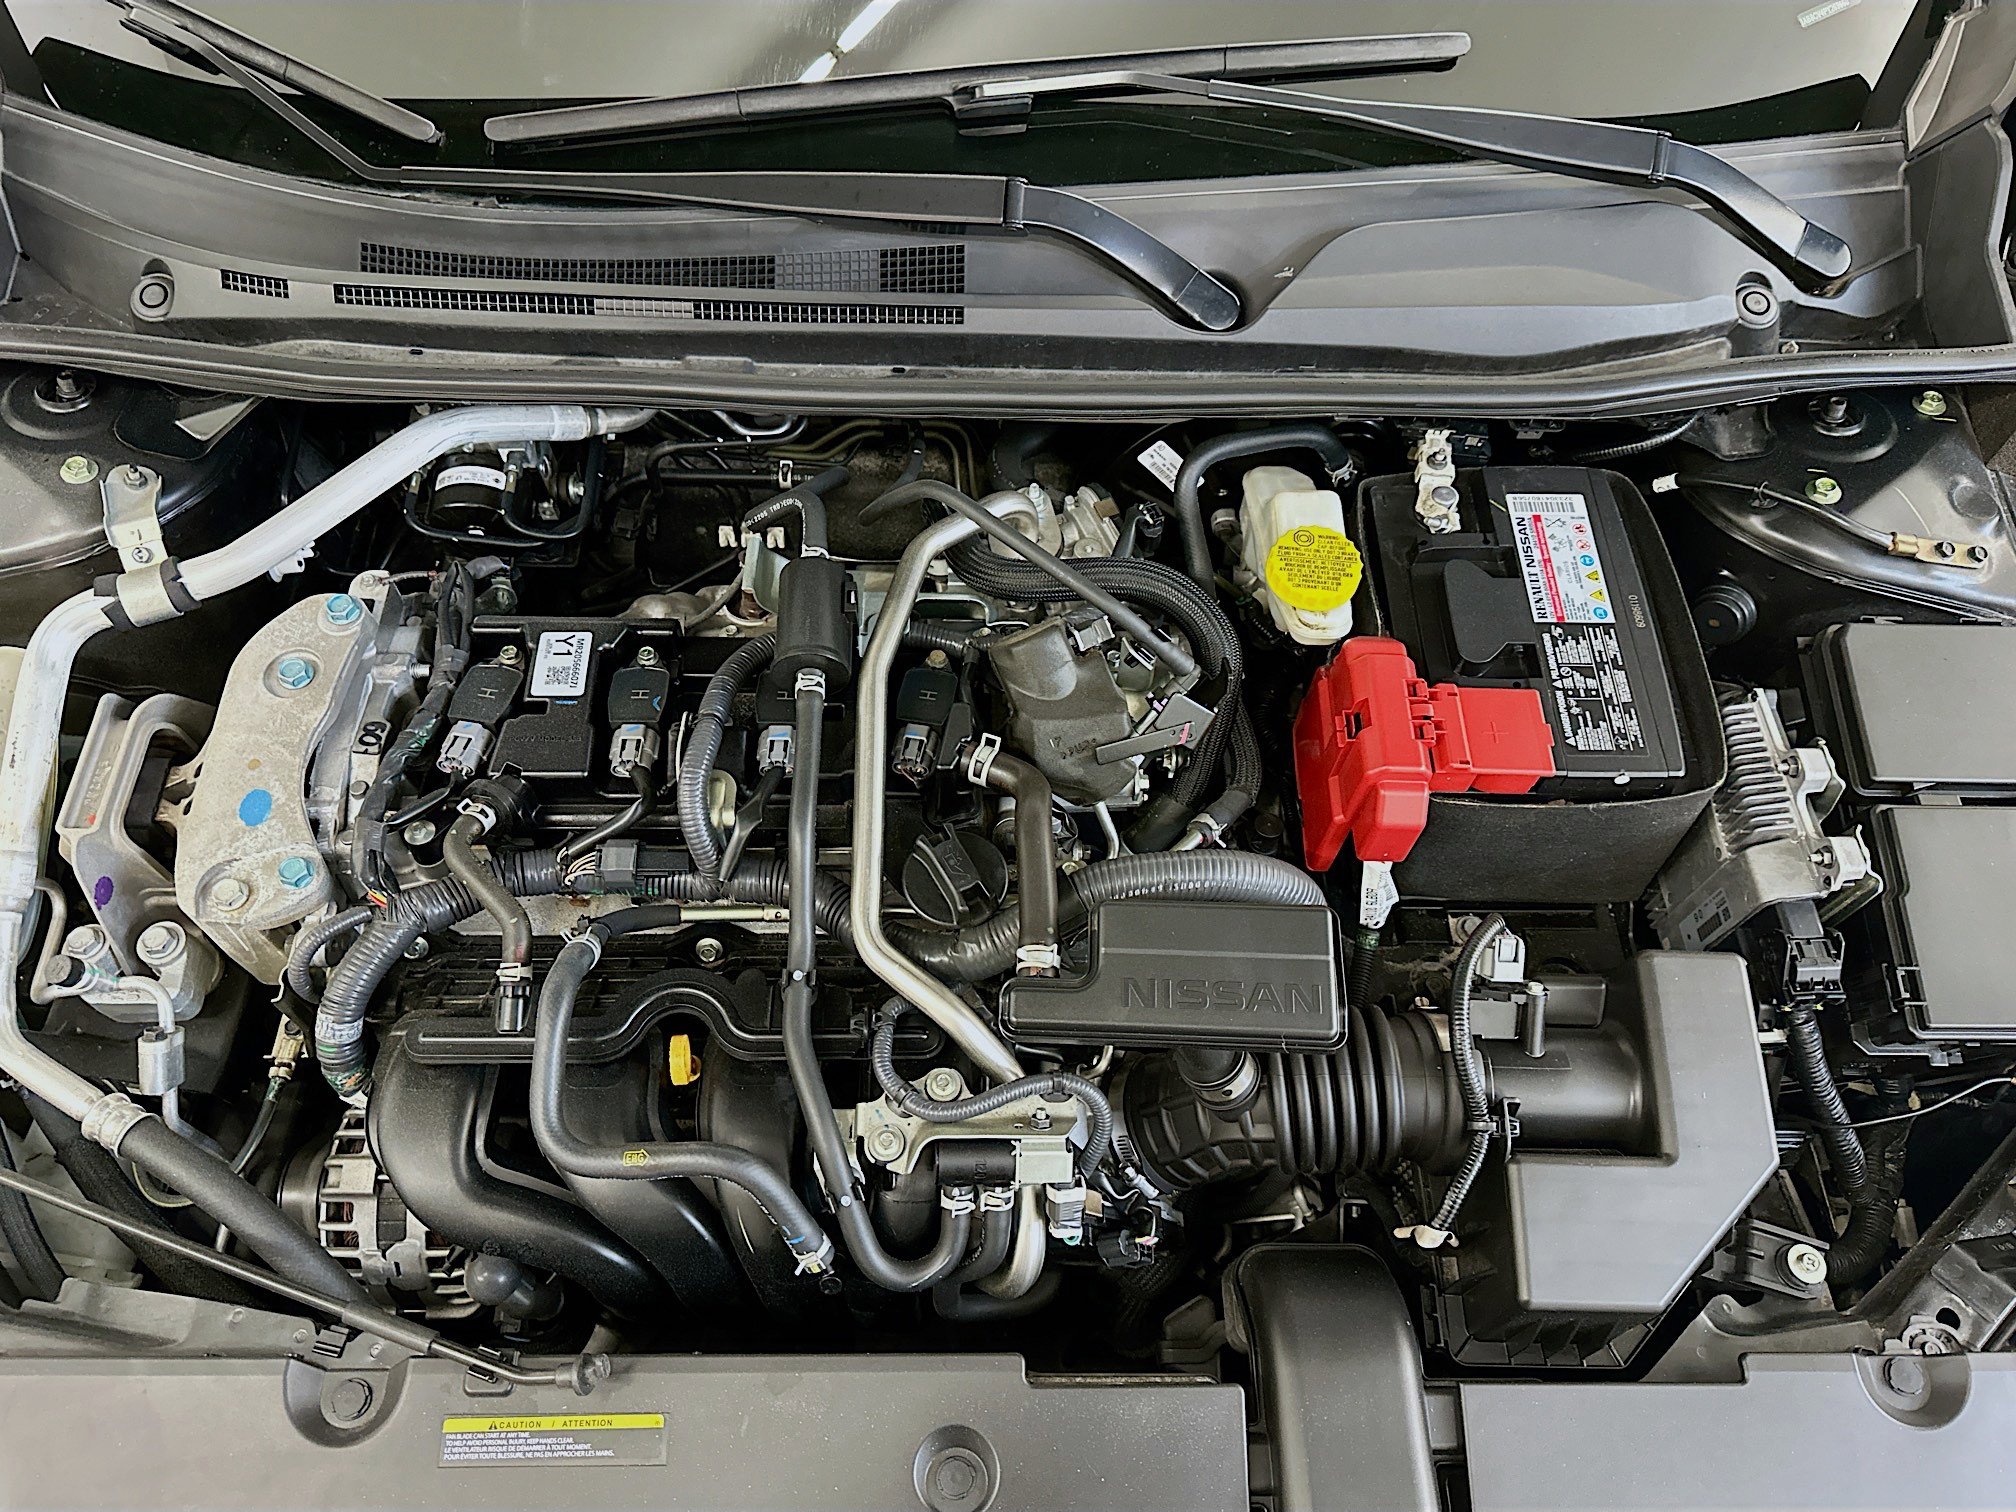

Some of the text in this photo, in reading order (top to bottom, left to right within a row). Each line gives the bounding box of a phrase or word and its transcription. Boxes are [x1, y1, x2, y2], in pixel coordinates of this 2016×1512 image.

[1516, 517, 1548, 619] RENAULT NISSAN
[552, 634, 576, 655] Y1
[1555, 691, 1574, 737] DANGER/POISON
[1122, 977, 1323, 1015] NISSAN
[499, 1420, 542, 1429] CAUTION
[562, 1419, 613, 1428] ATTENTION
[460, 1452, 479, 1460] ÉVITER
[488, 1445, 508, 1453] RISQUE
